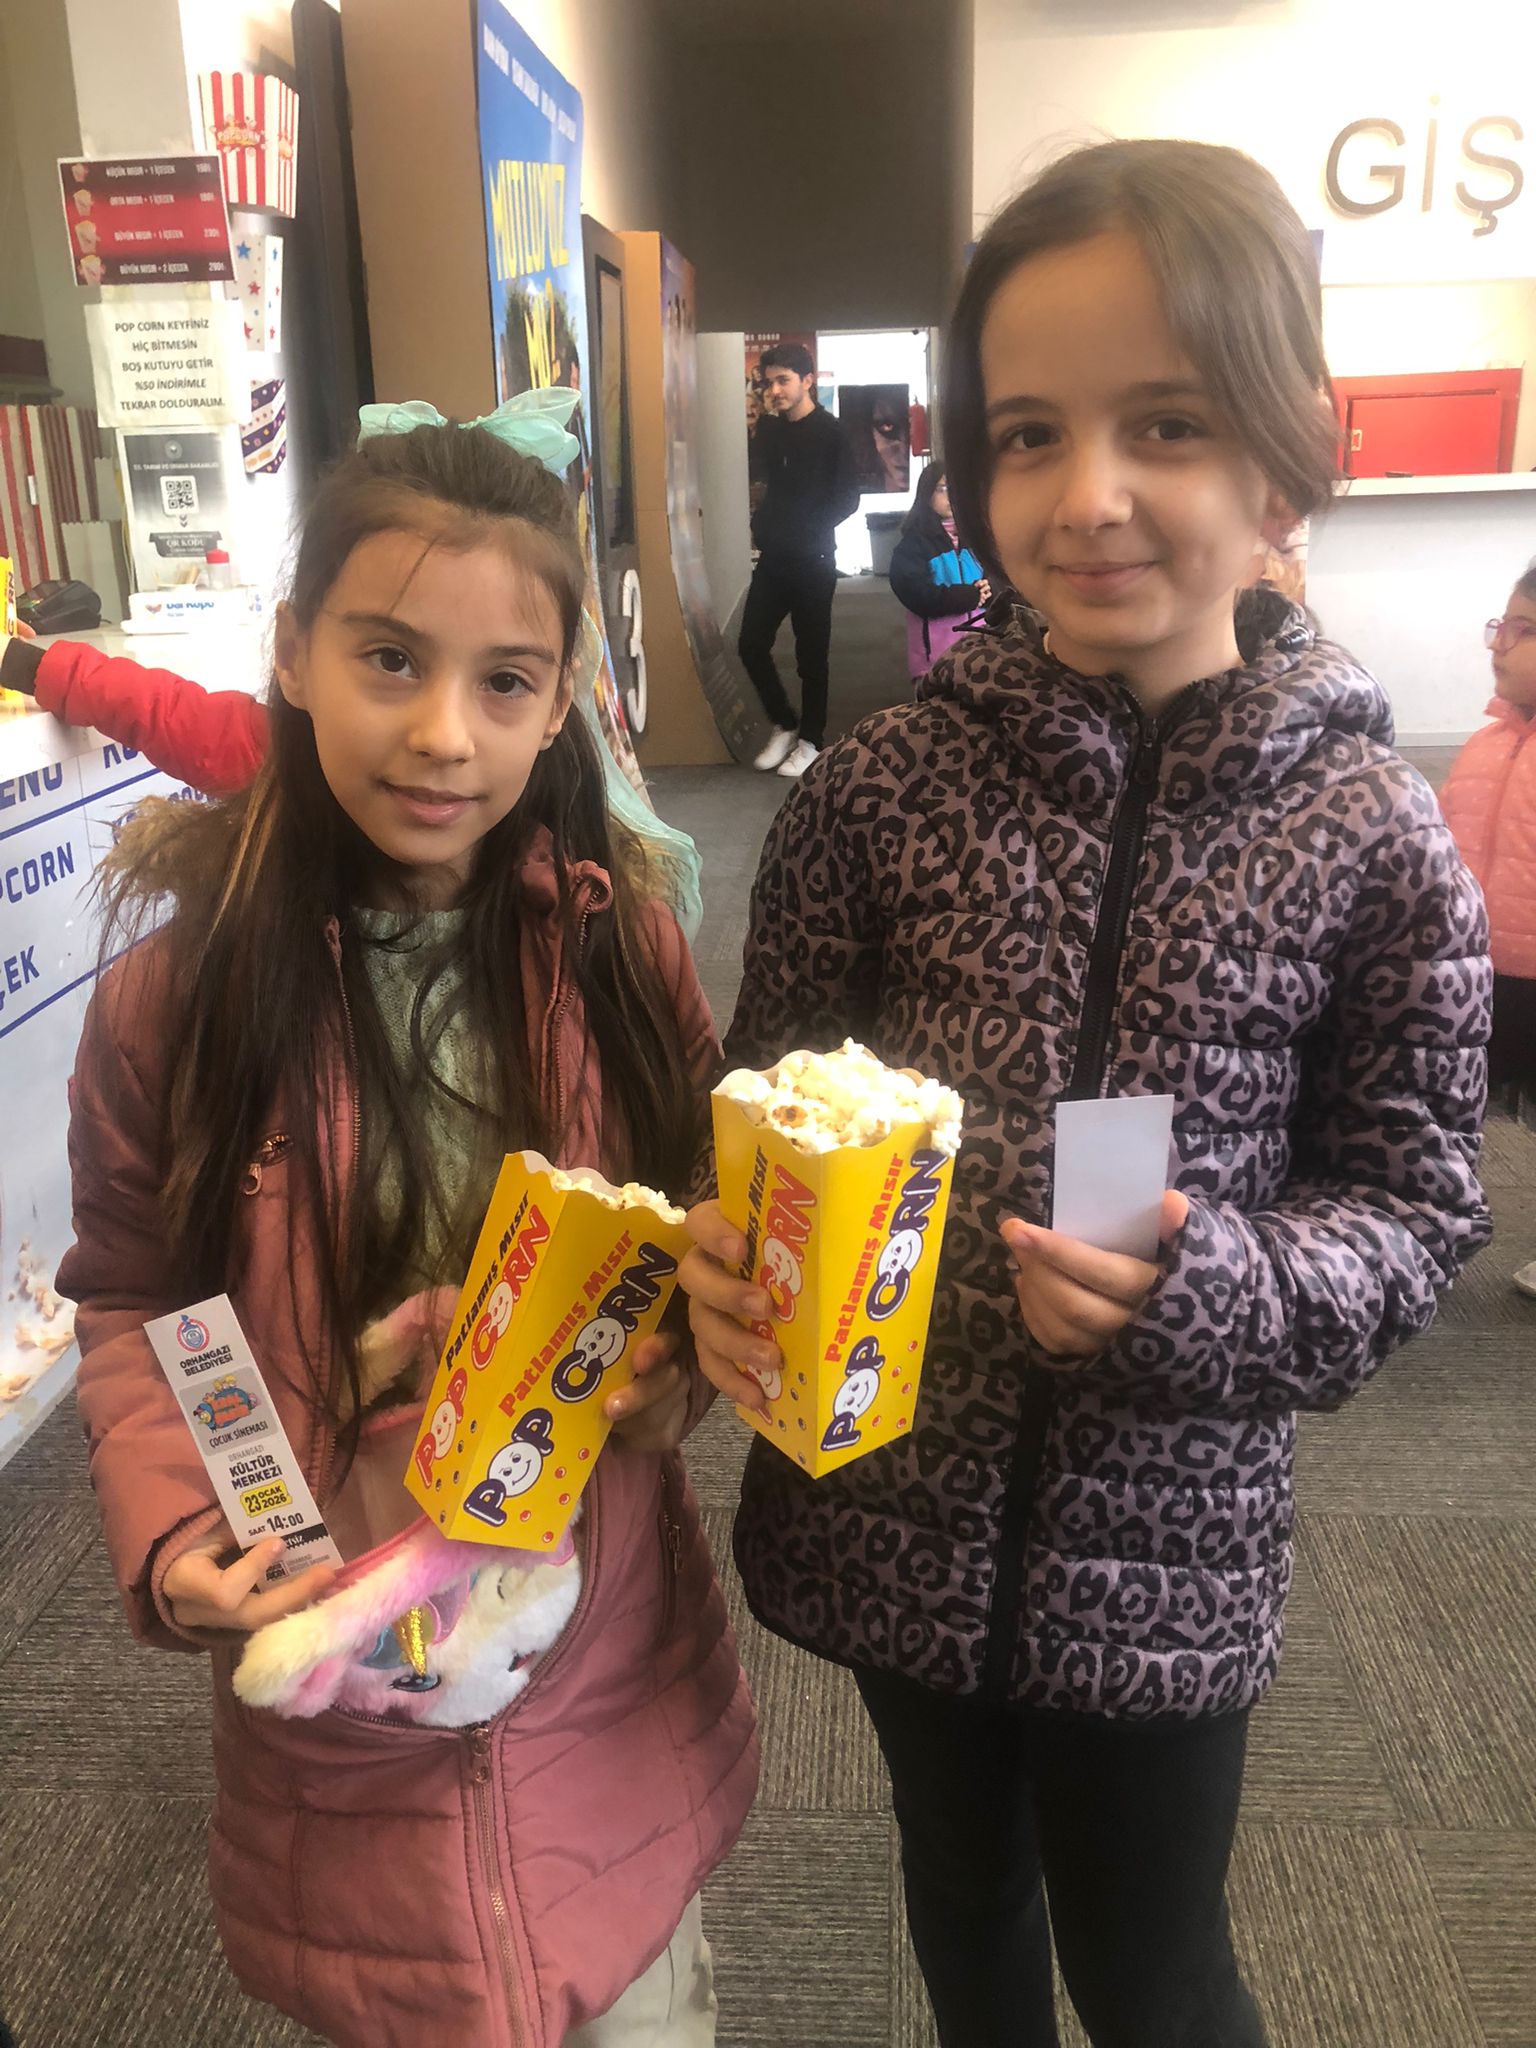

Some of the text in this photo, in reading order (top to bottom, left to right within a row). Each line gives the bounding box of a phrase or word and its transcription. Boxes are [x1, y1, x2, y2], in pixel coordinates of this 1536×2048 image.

[115, 317, 209, 333] POP CORN KEYFİNİZ
[132, 338, 198, 353] HİÇ BİTMESİN
[122, 356, 214, 373] BOŞ KUTUYU GETİR
[157, 378, 207, 390] İNDİRİMLE
[120, 400, 157, 411] TEKRAR
[0, 841, 75, 904] CORN
[0, 944, 40, 1011] EK
[759, 1162, 817, 1324] CORN
[823, 1152, 904, 1364] Patlamış Mısır
[445, 1189, 529, 1372] Patlamış Mısır
[820, 1148, 949, 1453] POP CORN
[498, 1229, 634, 1419] Patlamış Mısır
[415, 1204, 551, 1489] POP CORN
[184, 1353, 234, 1377] BELEDİYESİ
[462, 1241, 678, 1528] POP CORN
[209, 1420, 268, 1449] ÇOCUK SİNEMASI
[228, 1454, 275, 1478] KÜLTÜR
[231, 1465, 283, 1490] MERKEZİ
[244, 1485, 283, 1514] 23 OCAK
[262, 1493, 287, 1508] 2026
[248, 1511, 304, 1537] SAAT 14:00
